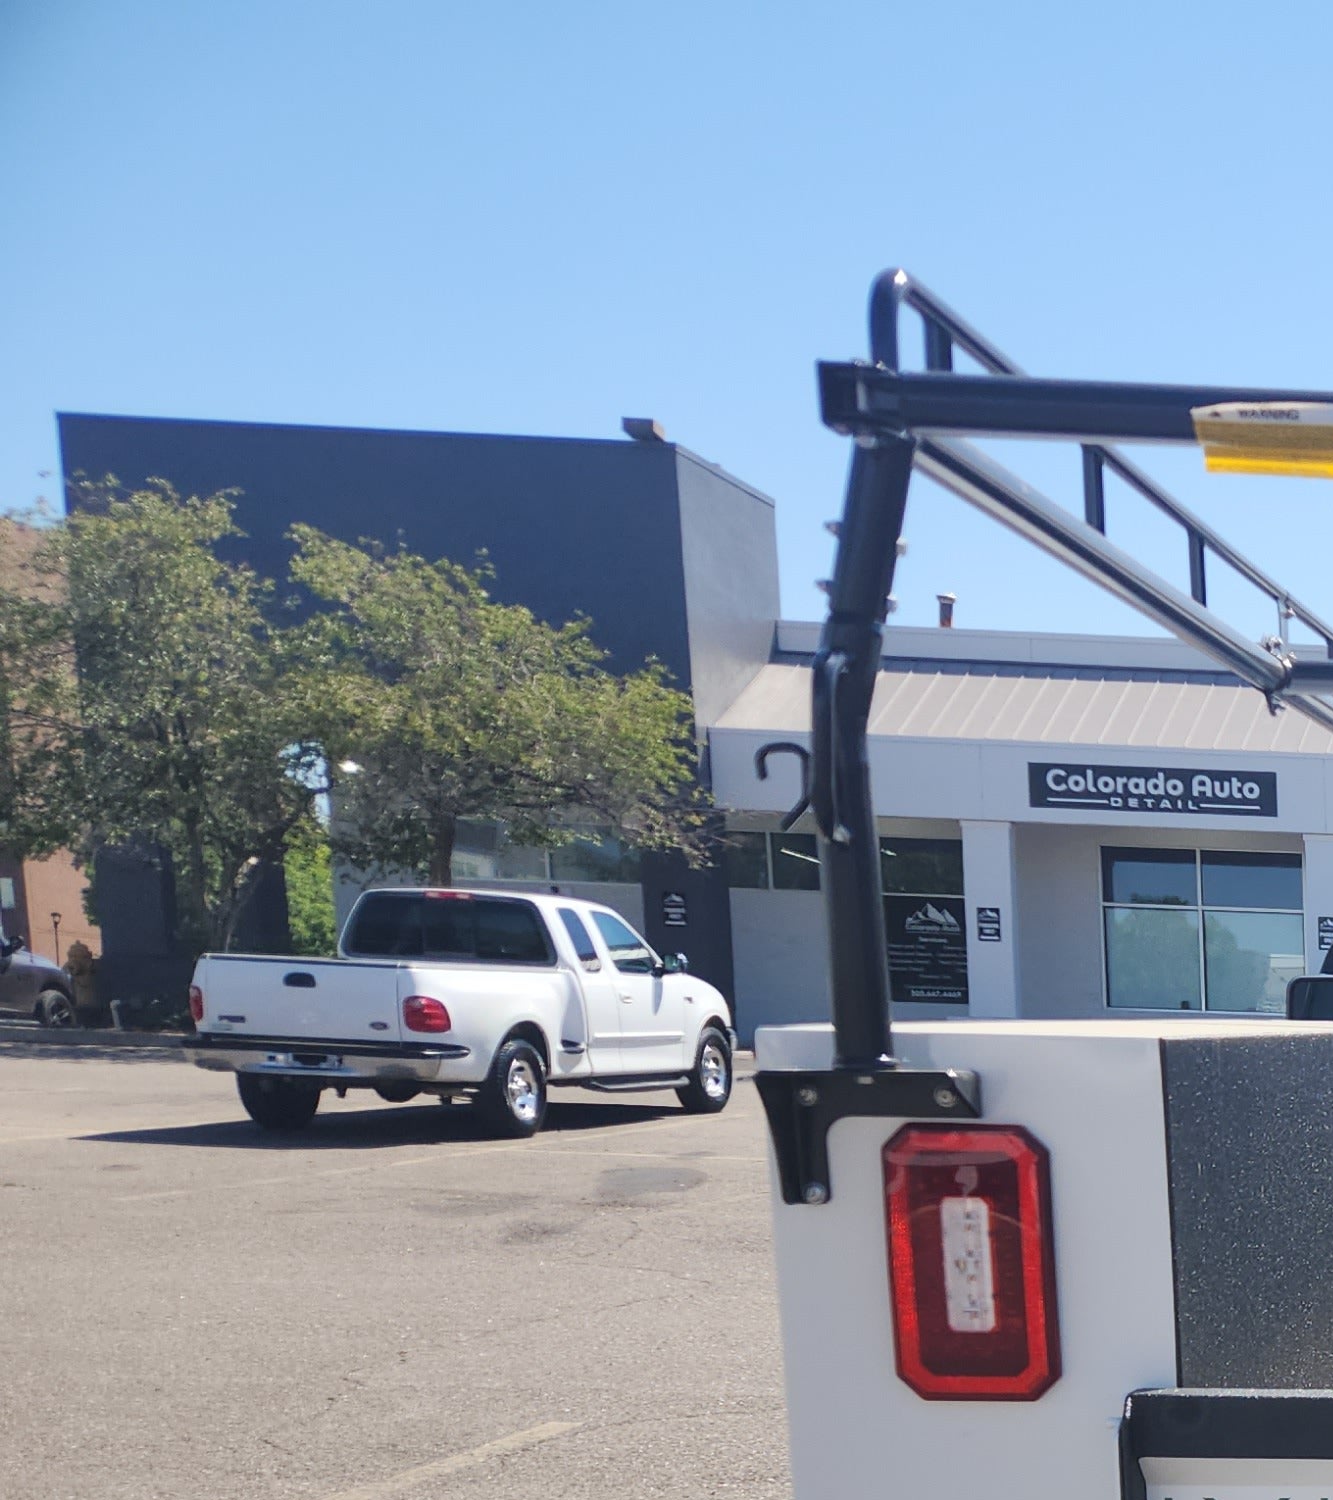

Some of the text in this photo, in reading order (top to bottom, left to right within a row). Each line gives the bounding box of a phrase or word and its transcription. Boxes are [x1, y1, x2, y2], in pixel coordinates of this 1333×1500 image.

[1046, 768, 1261, 799] Colorado Auto
[1109, 796, 1200, 810] DETAIL
